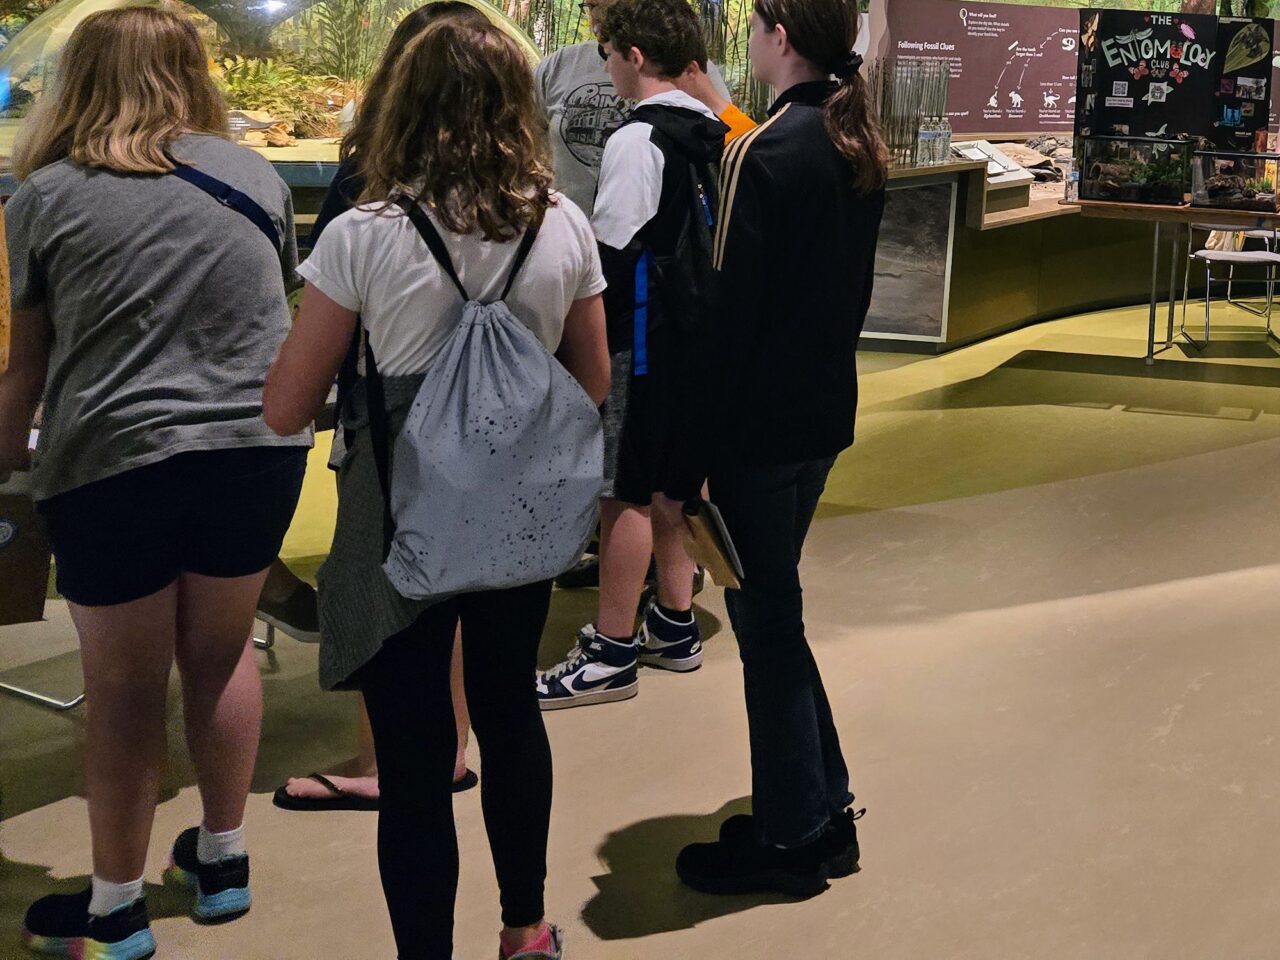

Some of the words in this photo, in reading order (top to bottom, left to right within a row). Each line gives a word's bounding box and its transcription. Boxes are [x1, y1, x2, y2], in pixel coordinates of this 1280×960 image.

[1151, 15, 1172, 25] THE
[897, 41, 923, 51] Following
[924, 41, 939, 50] Fossil
[940, 42, 955, 51] Clues
[1151, 59, 1170, 69] CLUB
